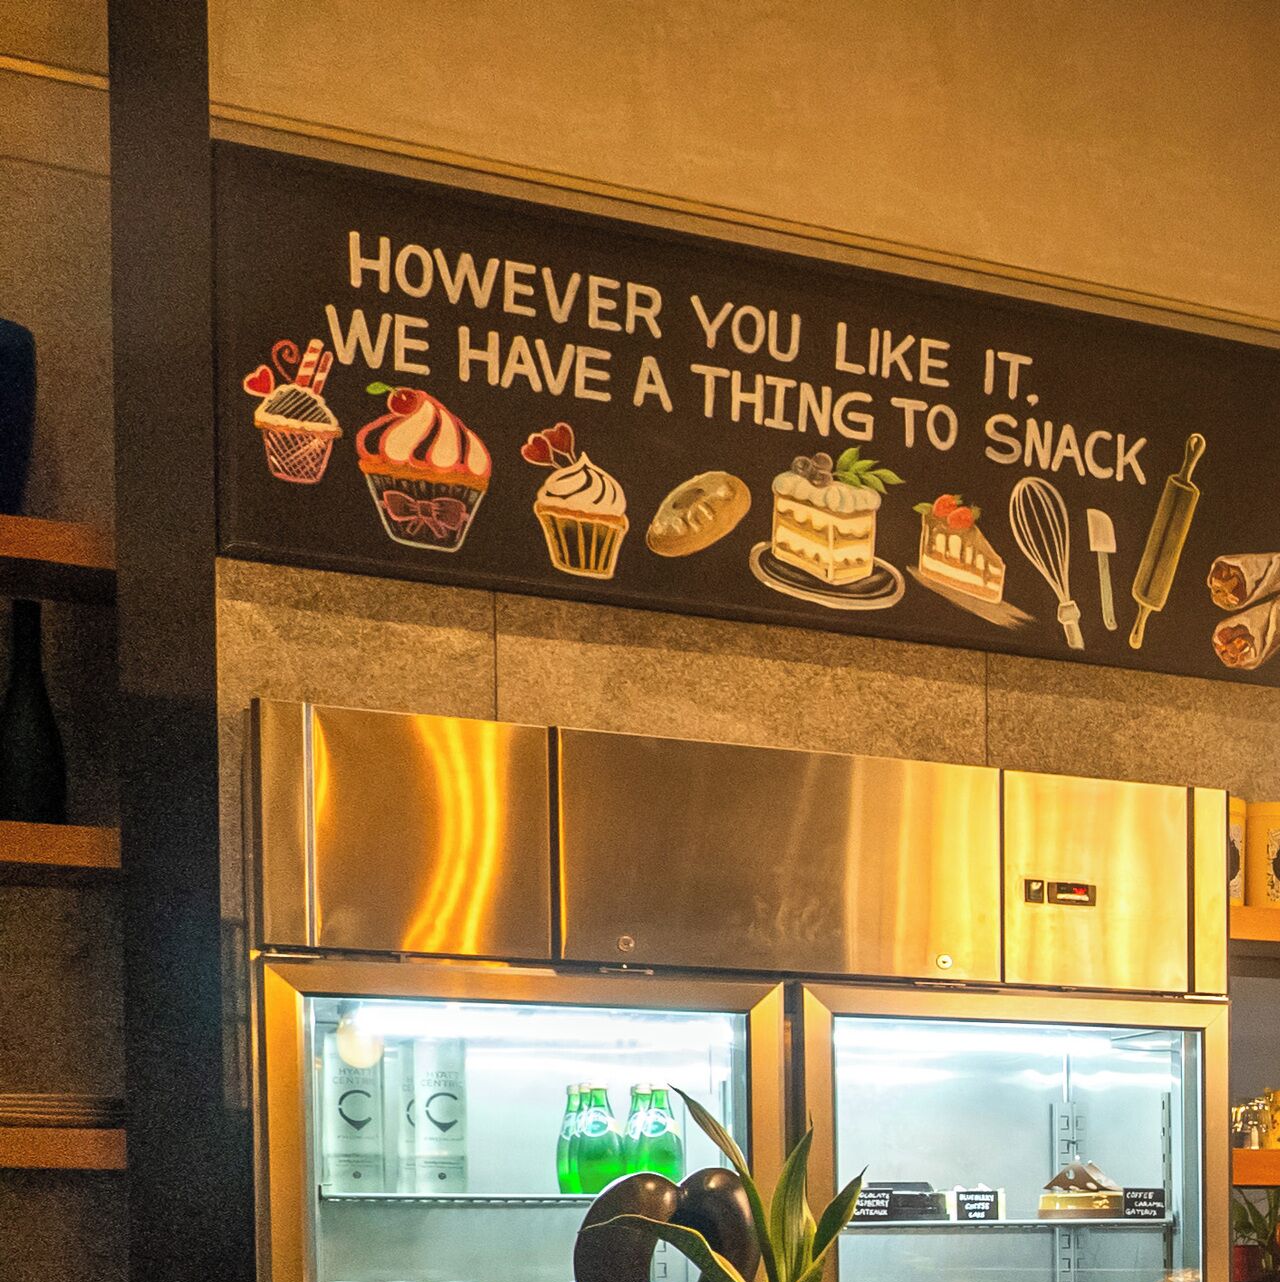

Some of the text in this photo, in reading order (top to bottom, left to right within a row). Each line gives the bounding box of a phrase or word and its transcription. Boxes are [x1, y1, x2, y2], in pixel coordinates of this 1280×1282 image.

[349, 231, 662, 338] HOWEVER
[691, 294, 801, 363] YOU
[835, 322, 950, 388] LIKE
[325, 304, 1148, 485] WE HAVE A THING TO SNACK
[1126, 1191, 1154, 1199] COFFEE
